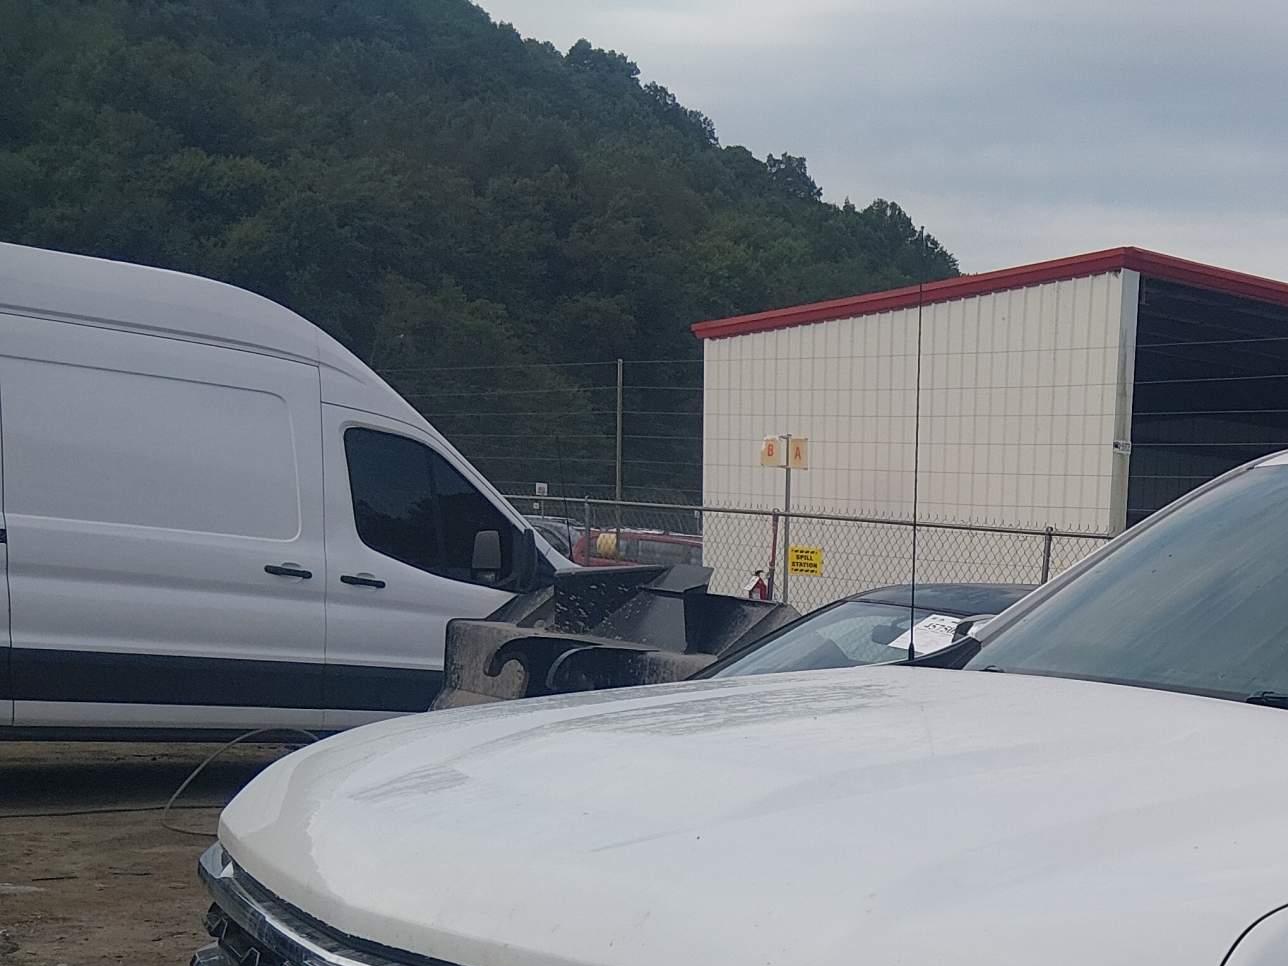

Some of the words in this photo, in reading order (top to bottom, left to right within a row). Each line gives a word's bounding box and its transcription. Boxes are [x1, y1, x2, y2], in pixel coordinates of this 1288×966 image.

[767, 443, 774, 457] B
[794, 446, 802, 461] A
[795, 554, 814, 562] SPILL
[791, 561, 818, 569] STATION
